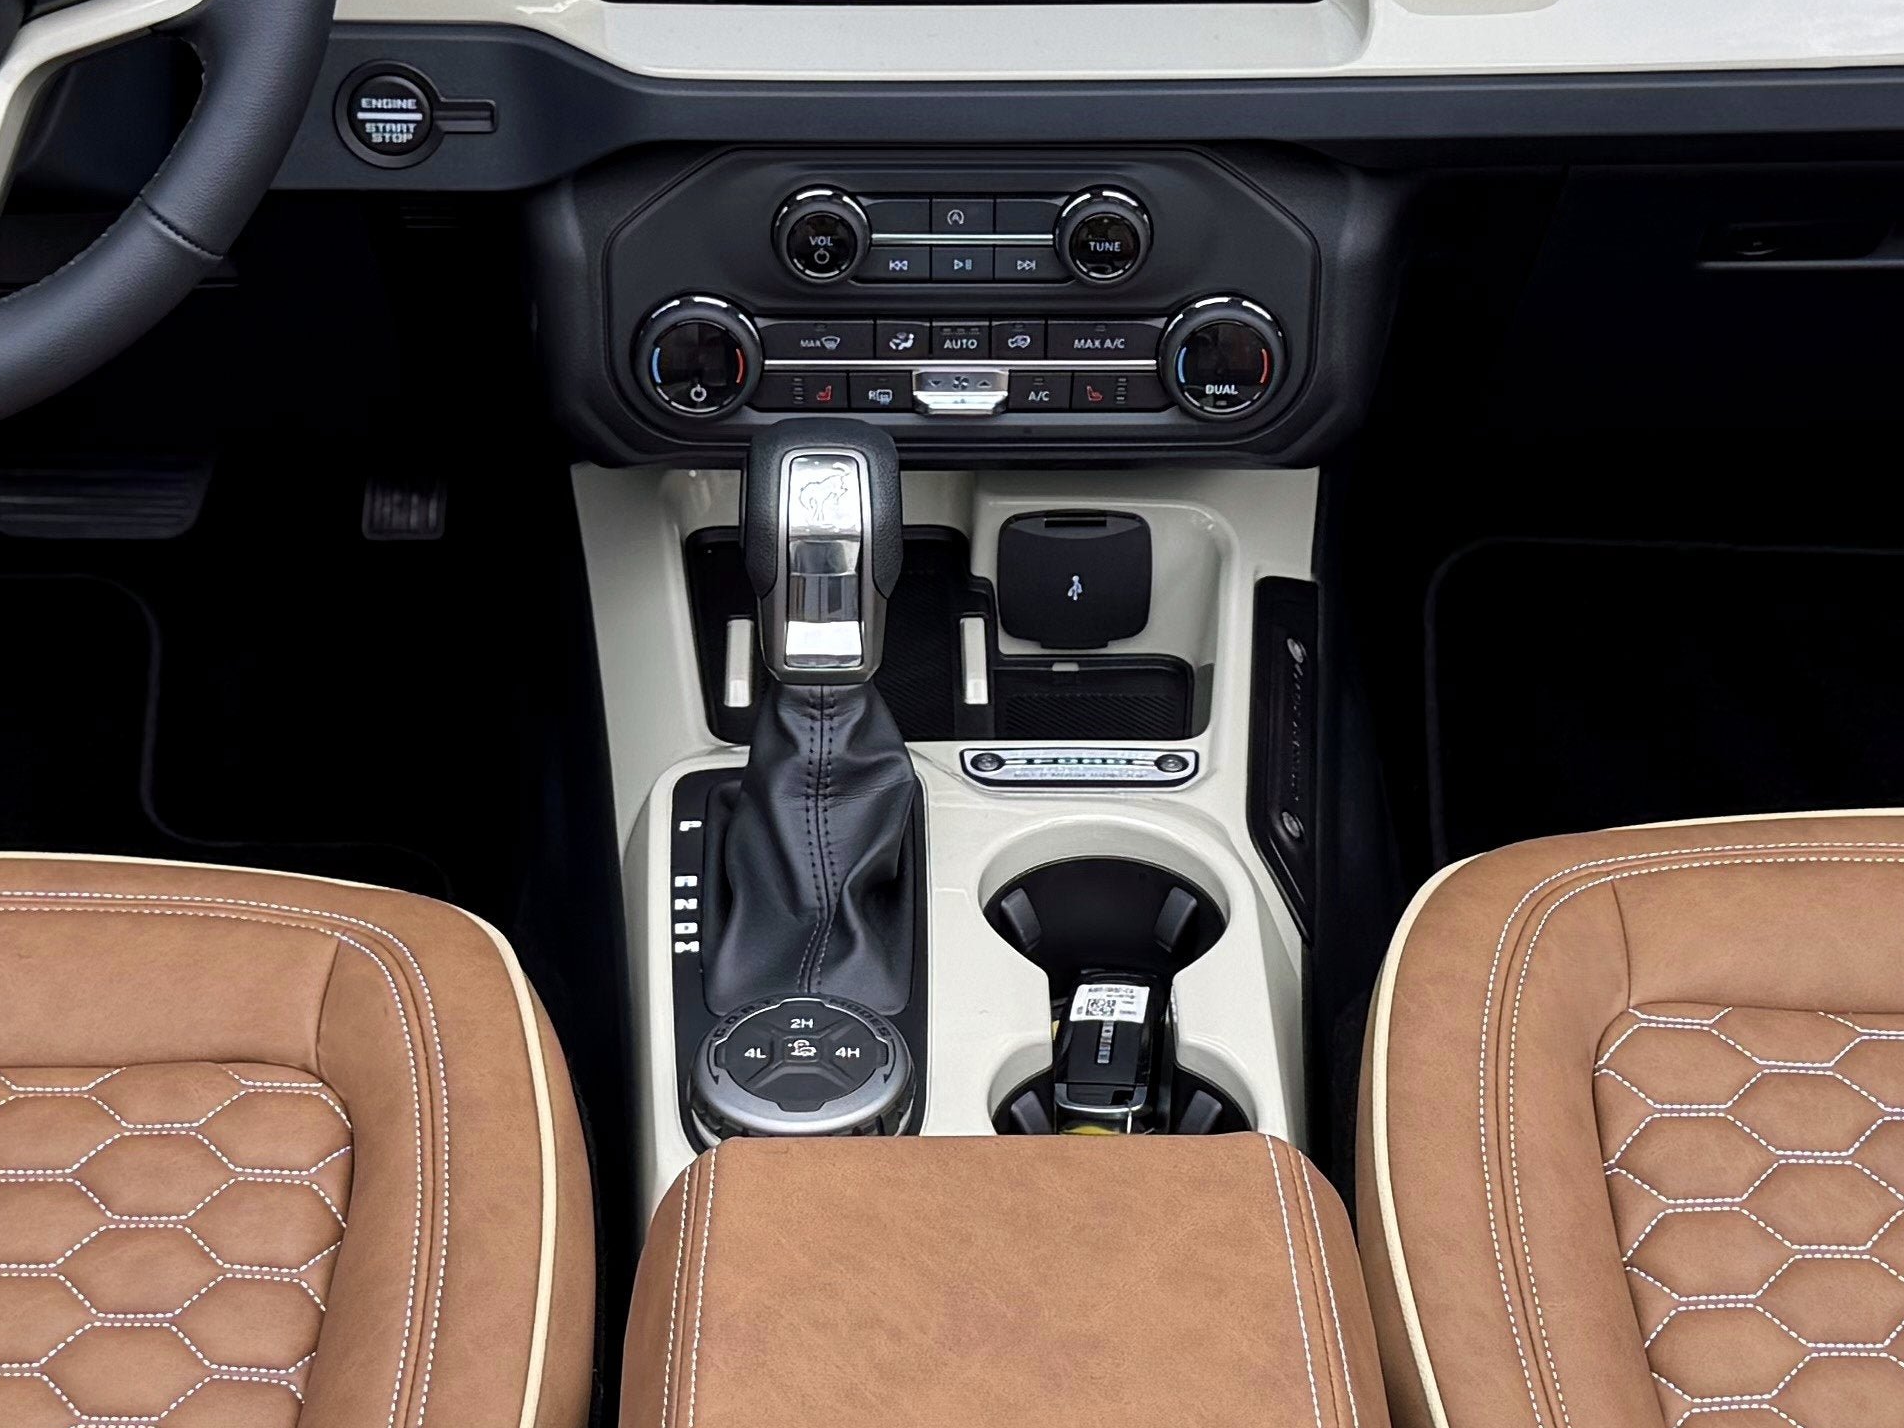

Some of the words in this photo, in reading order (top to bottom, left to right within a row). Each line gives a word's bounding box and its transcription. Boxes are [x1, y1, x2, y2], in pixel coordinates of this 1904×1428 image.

[360, 98, 417, 110] ENGINE
[365, 123, 417, 133] START
[371, 133, 413, 144] STOP
[809, 236, 834, 247] VOL
[1089, 241, 1122, 253] TUNE
[943, 339, 978, 349] AUTO
[1073, 338, 1102, 349] MAX
[1104, 338, 1126, 350] A/C
[1205, 384, 1239, 395] DUAL
[1028, 391, 1050, 401] A/C
[679, 821, 703, 831] P
[674, 898, 698, 910] N
[674, 922, 698, 934] D
[674, 941, 700, 953] M
[790, 1018, 814, 1028] 2H
[744, 1047, 767, 1059] 4L
[835, 1047, 860, 1058] 4H
